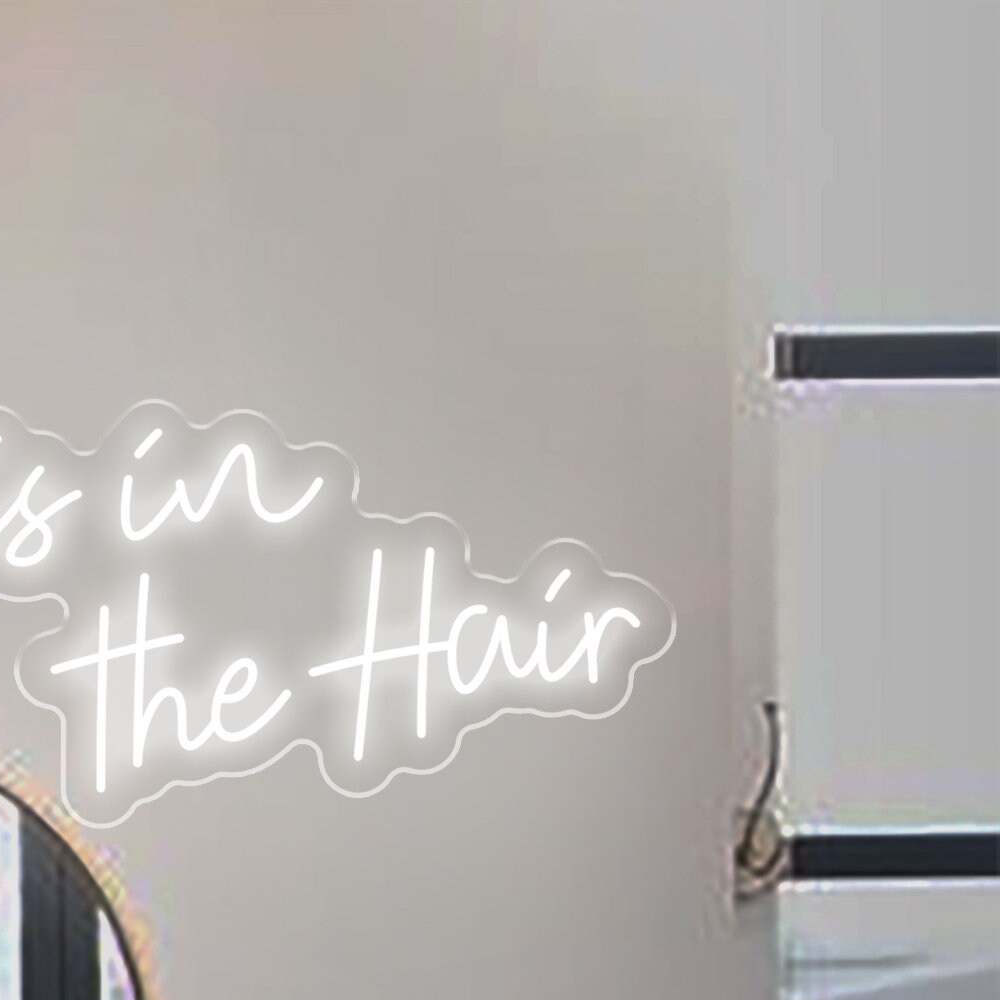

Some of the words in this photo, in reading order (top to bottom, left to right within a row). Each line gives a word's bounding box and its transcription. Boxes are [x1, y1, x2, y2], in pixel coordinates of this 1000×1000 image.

[120, 428, 323, 541] in
[50, 573, 291, 793] the
[308, 546, 640, 761] Hair
